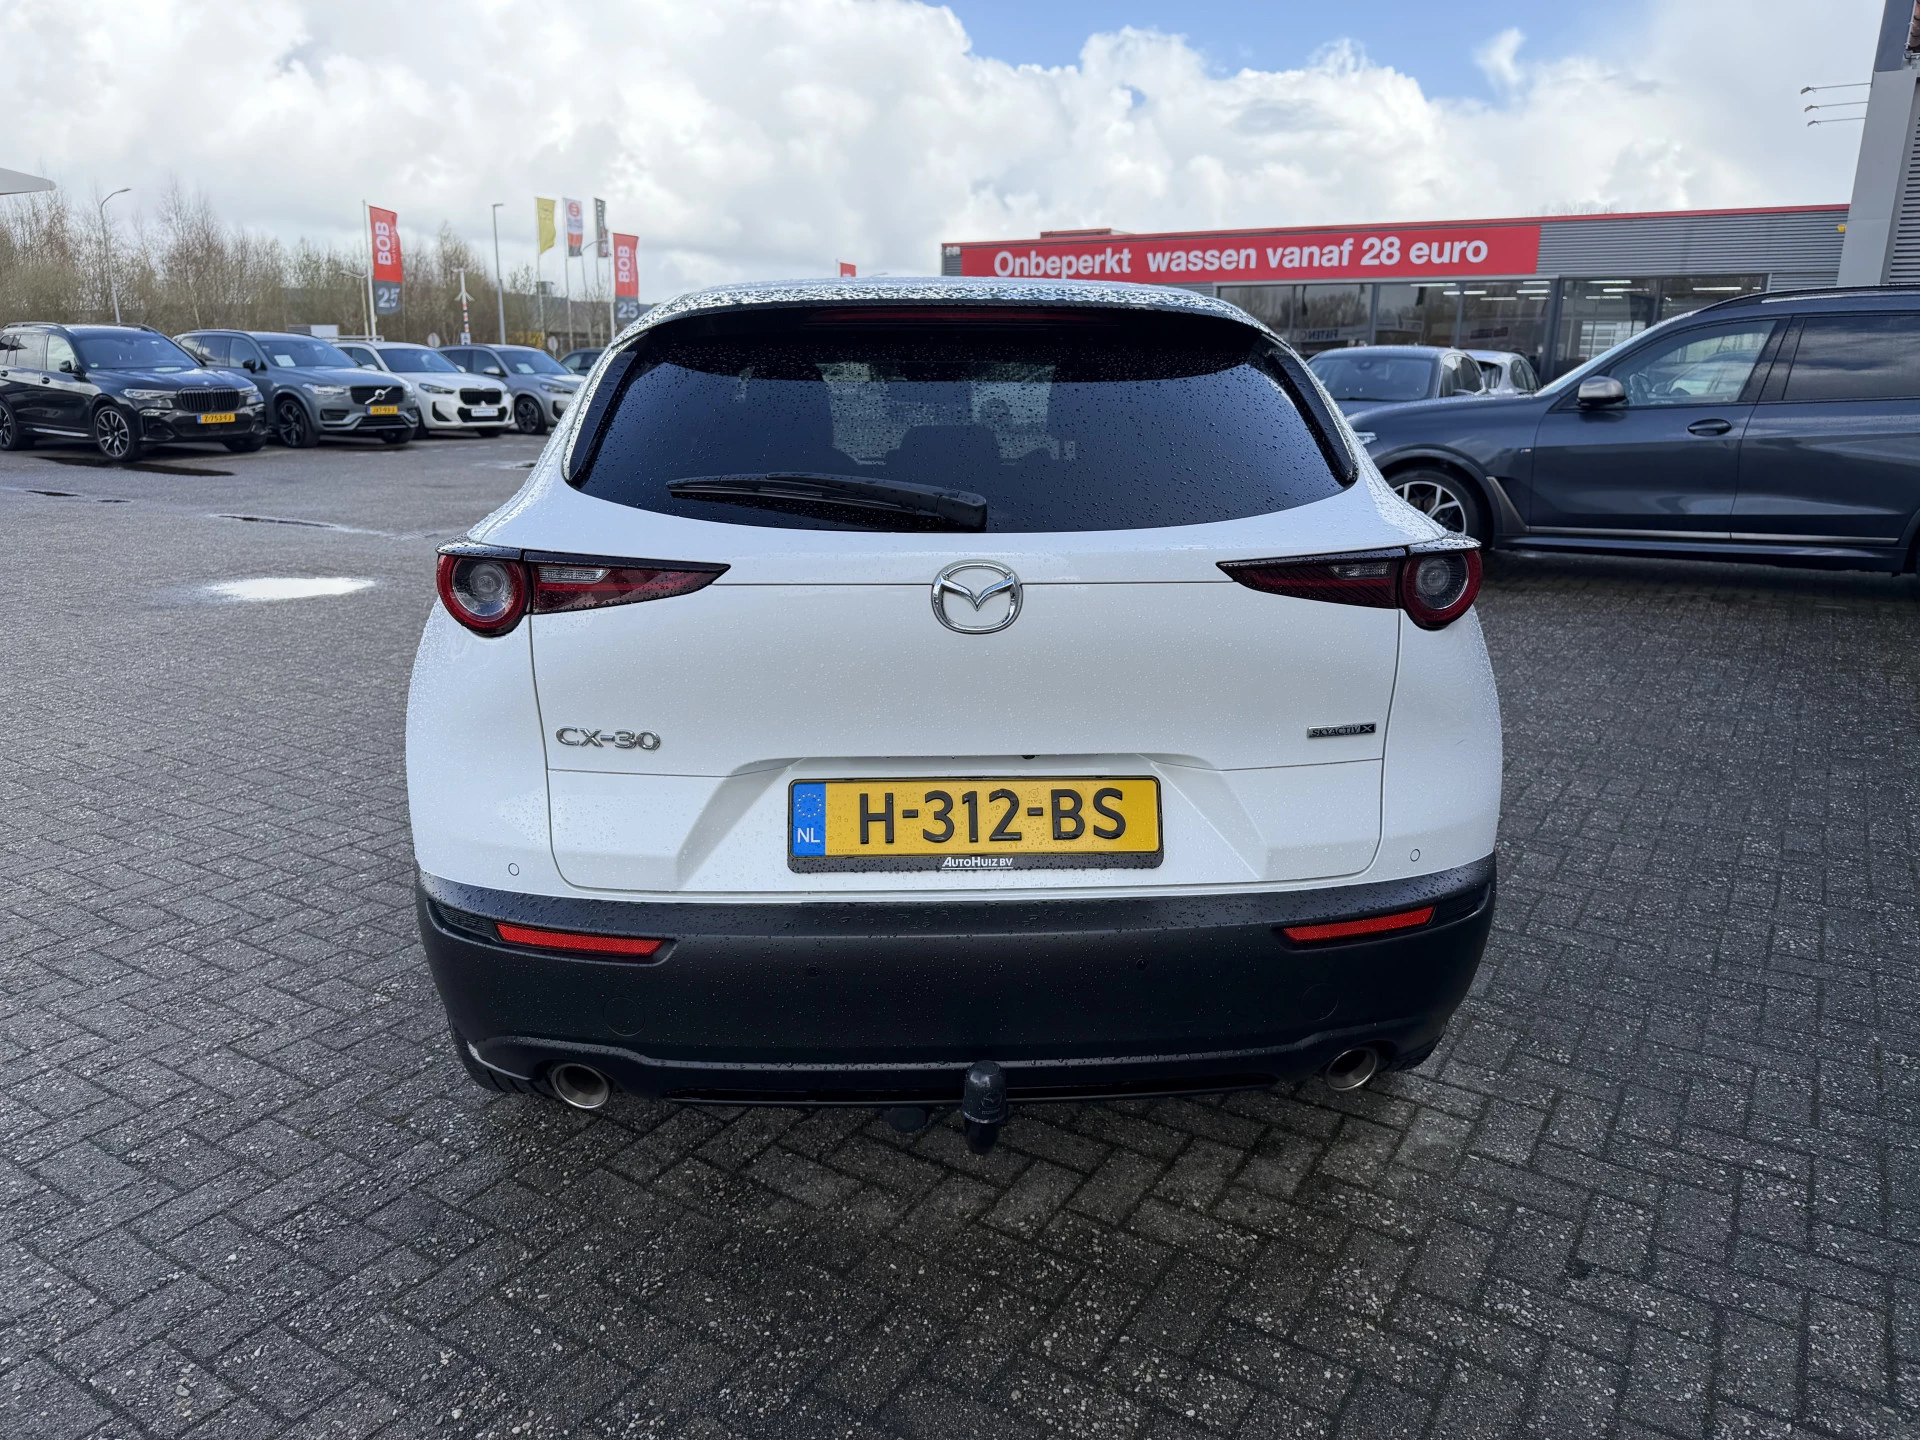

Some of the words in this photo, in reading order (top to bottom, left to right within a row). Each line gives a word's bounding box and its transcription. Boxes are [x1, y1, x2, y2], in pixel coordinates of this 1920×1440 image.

[375, 221, 392, 266] BOB
[617, 245, 631, 283] BOB
[993, 247, 1132, 279] Onbeperkt
[1147, 247, 1257, 273] wassen
[1266, 238, 1355, 269] vanaf
[1360, 236, 1401, 266] 28
[1409, 239, 1489, 265] euro
[377, 287, 401, 308] 25
[617, 301, 639, 319] 25
[556, 726, 661, 751] CX-30
[1311, 725, 1360, 737] SKYACTIV
[859, 787, 1127, 844] H-312-BS
[797, 827, 821, 844] NL
[999, 858, 1013, 867] BV
